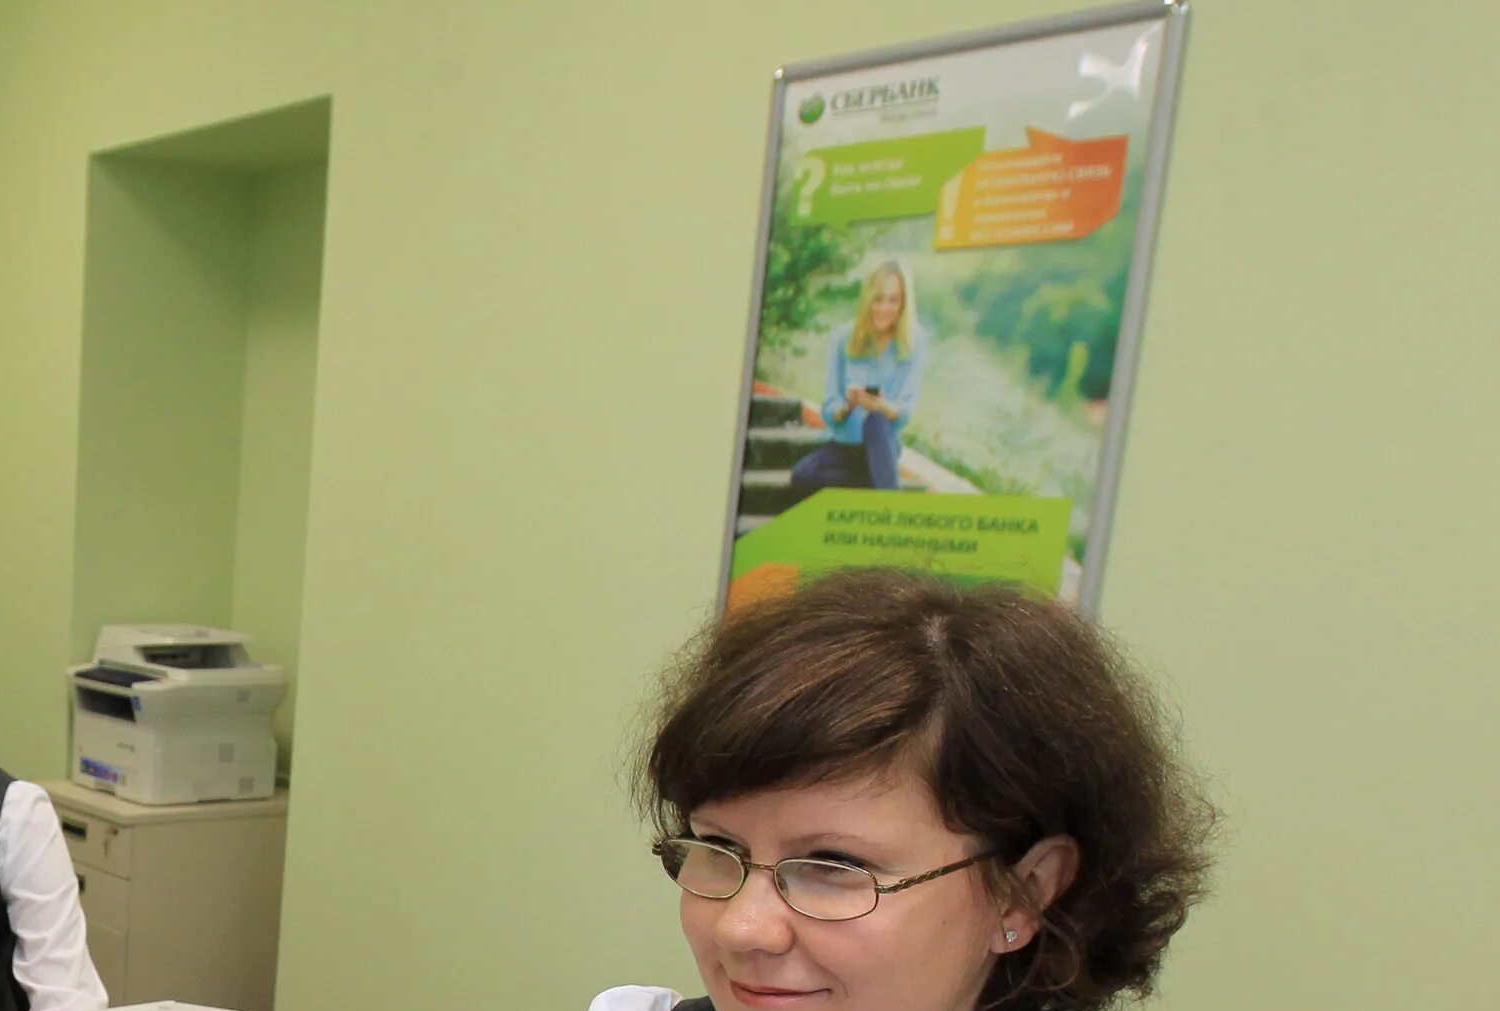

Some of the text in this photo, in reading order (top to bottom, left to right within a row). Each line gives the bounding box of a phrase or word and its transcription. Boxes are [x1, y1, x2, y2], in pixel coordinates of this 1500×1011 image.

[829, 77, 940, 112] СБЕРБАНК
[826, 507, 1039, 534] КАРТОЙ ЛЮБОГО БАНКА
[823, 530, 858, 545] ИЛИ
